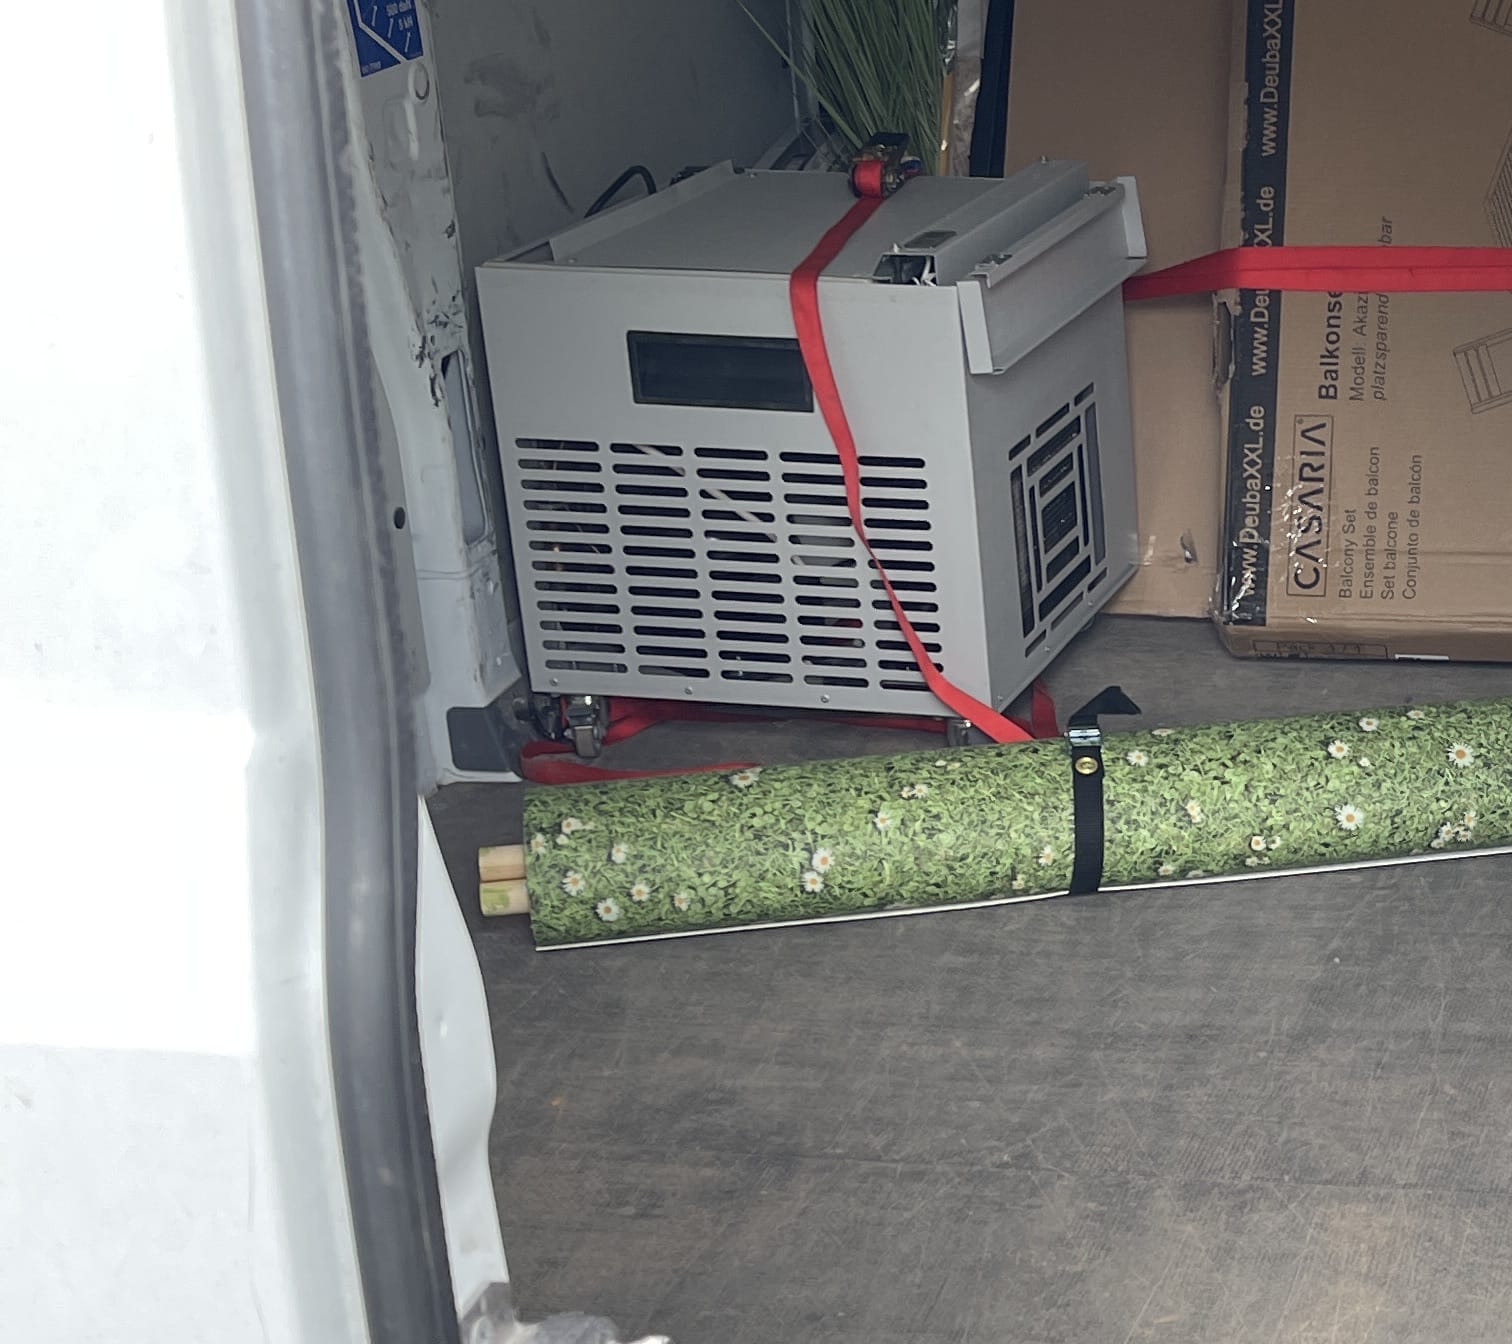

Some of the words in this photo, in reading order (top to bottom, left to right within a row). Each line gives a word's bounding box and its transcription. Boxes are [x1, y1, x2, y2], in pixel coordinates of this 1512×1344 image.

[1371, 293, 1391, 401] platzsparend
[1365, 446, 1381, 497] balcon
[1407, 454, 1423, 509] balcón
[1293, 422, 1328, 590] CASARIA
[1341, 508, 1357, 534] Set
[1364, 500, 1378, 521] de
[1406, 508, 1420, 528] de
[1338, 541, 1359, 598] Balcony
[1359, 524, 1377, 599] Ensemble
[1383, 511, 1399, 572] balcone
[1402, 534, 1421, 600] Conjunto
[1381, 575, 1395, 600] Set
